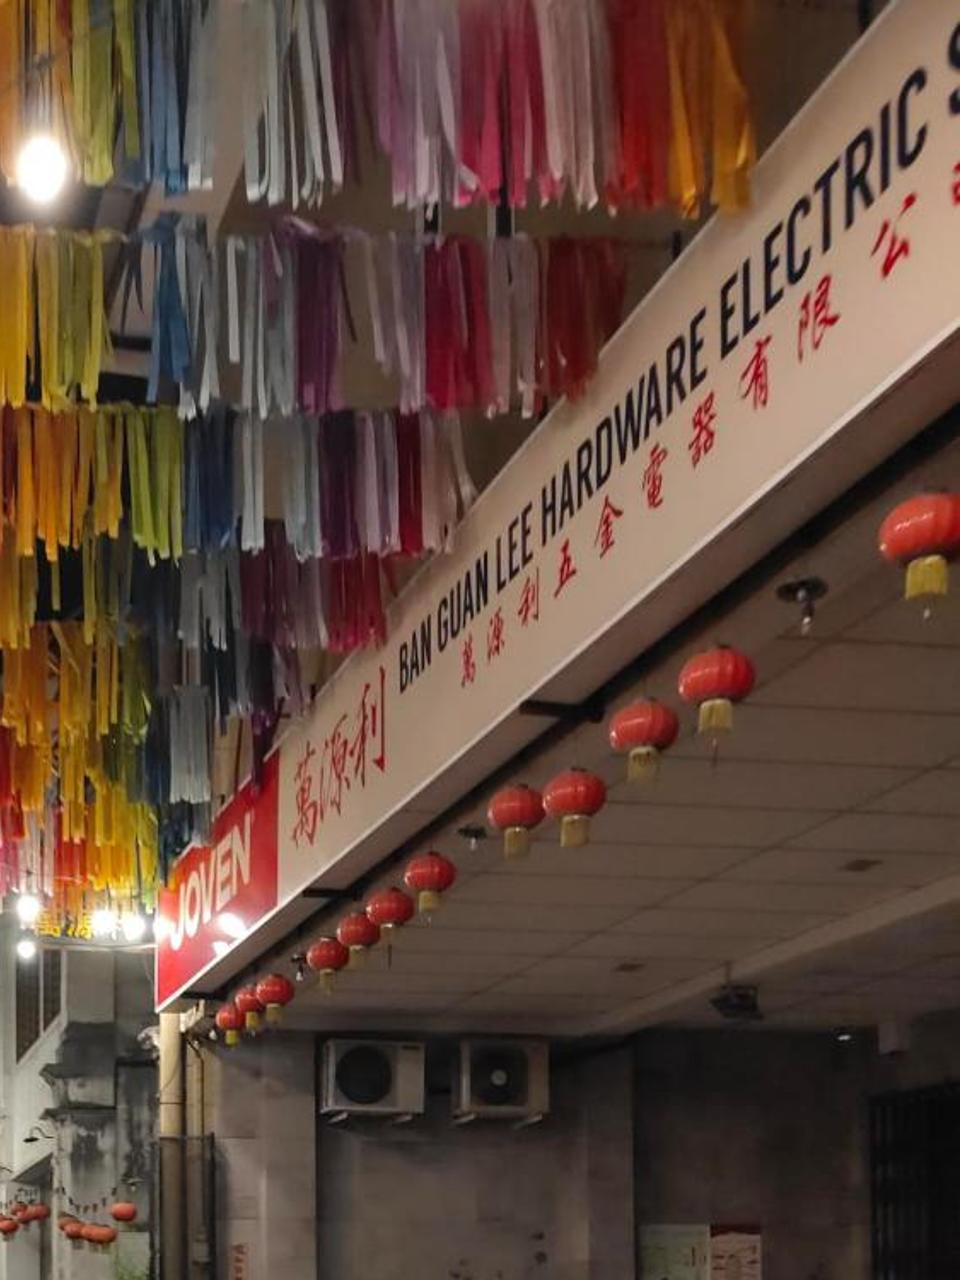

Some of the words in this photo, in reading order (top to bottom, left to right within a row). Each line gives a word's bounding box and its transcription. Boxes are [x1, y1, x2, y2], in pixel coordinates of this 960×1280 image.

[399, 614, 432, 693] BAN
[437, 551, 489, 652] GUAN
[496, 503, 533, 593] LEE
[542, 306, 707, 547] HARDWARE
[720, 66, 928, 360] ELECTRIC
[170, 808, 252, 951] JOVEN
